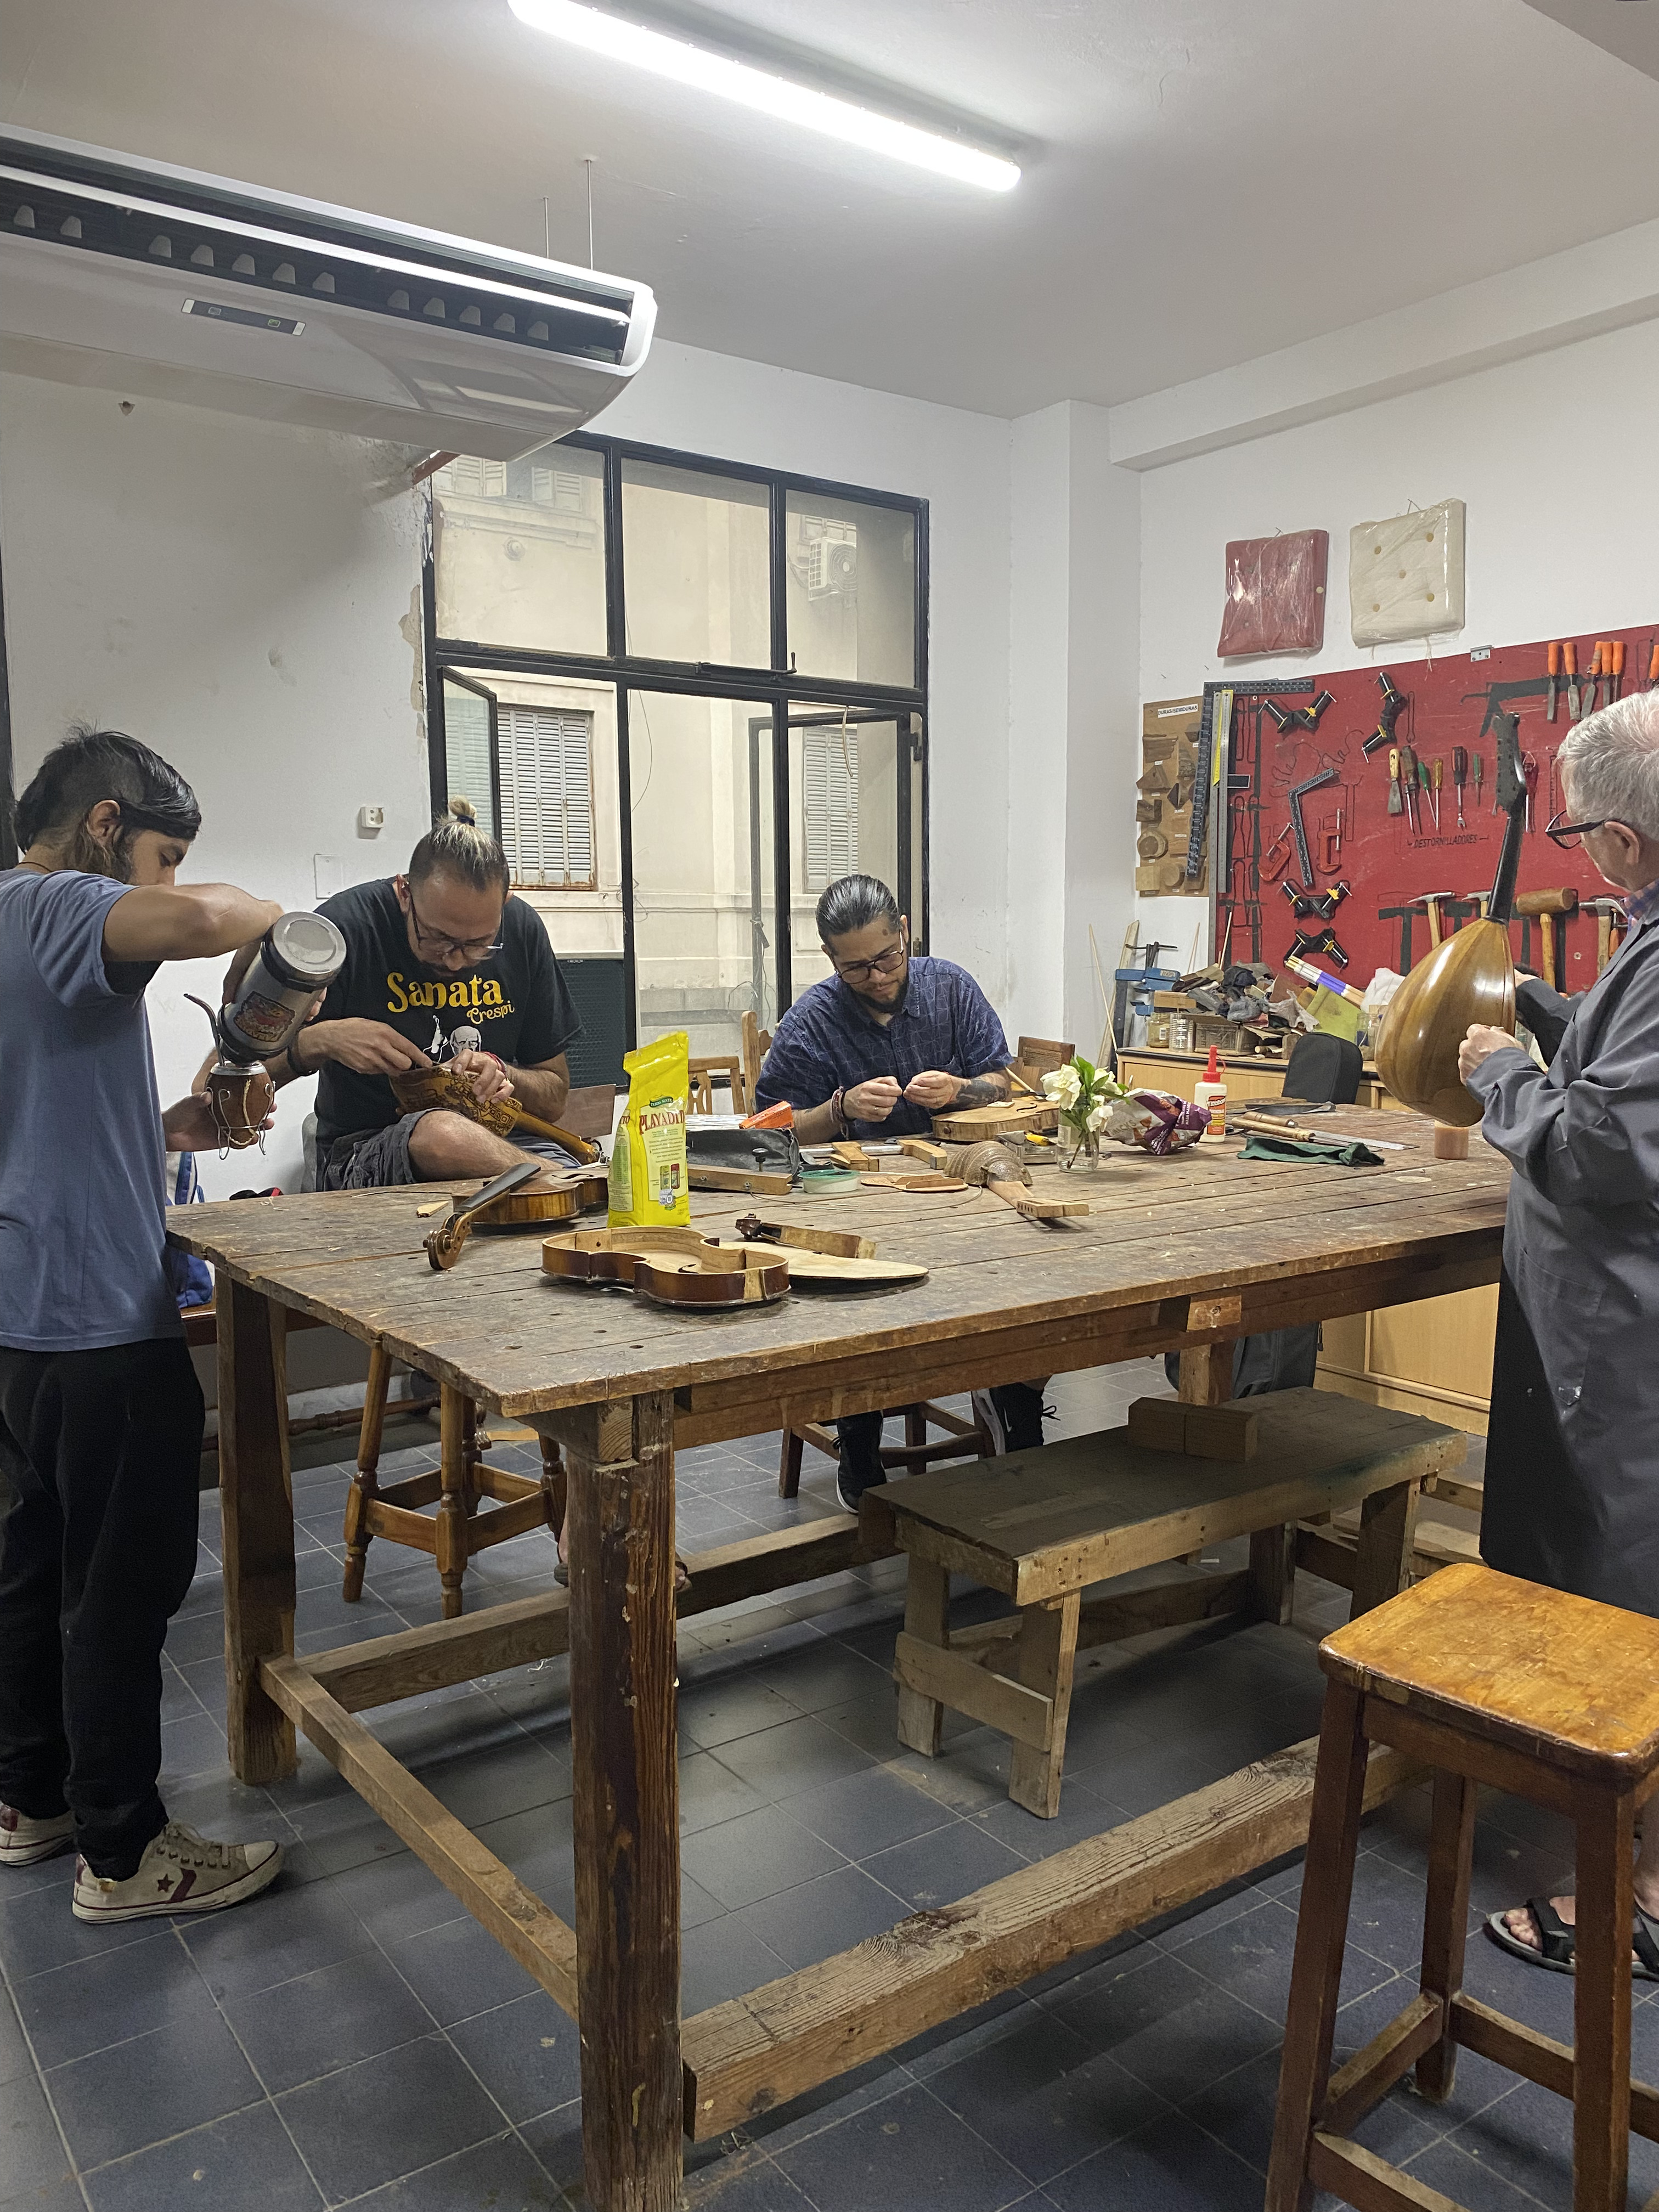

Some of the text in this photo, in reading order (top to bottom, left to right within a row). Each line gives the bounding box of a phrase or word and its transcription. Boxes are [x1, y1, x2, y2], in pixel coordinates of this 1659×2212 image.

[387, 972, 504, 1013] Sanata
[466, 1000, 515, 1024] Crespi
[639, 1110, 685, 1136] PLAYADIT
